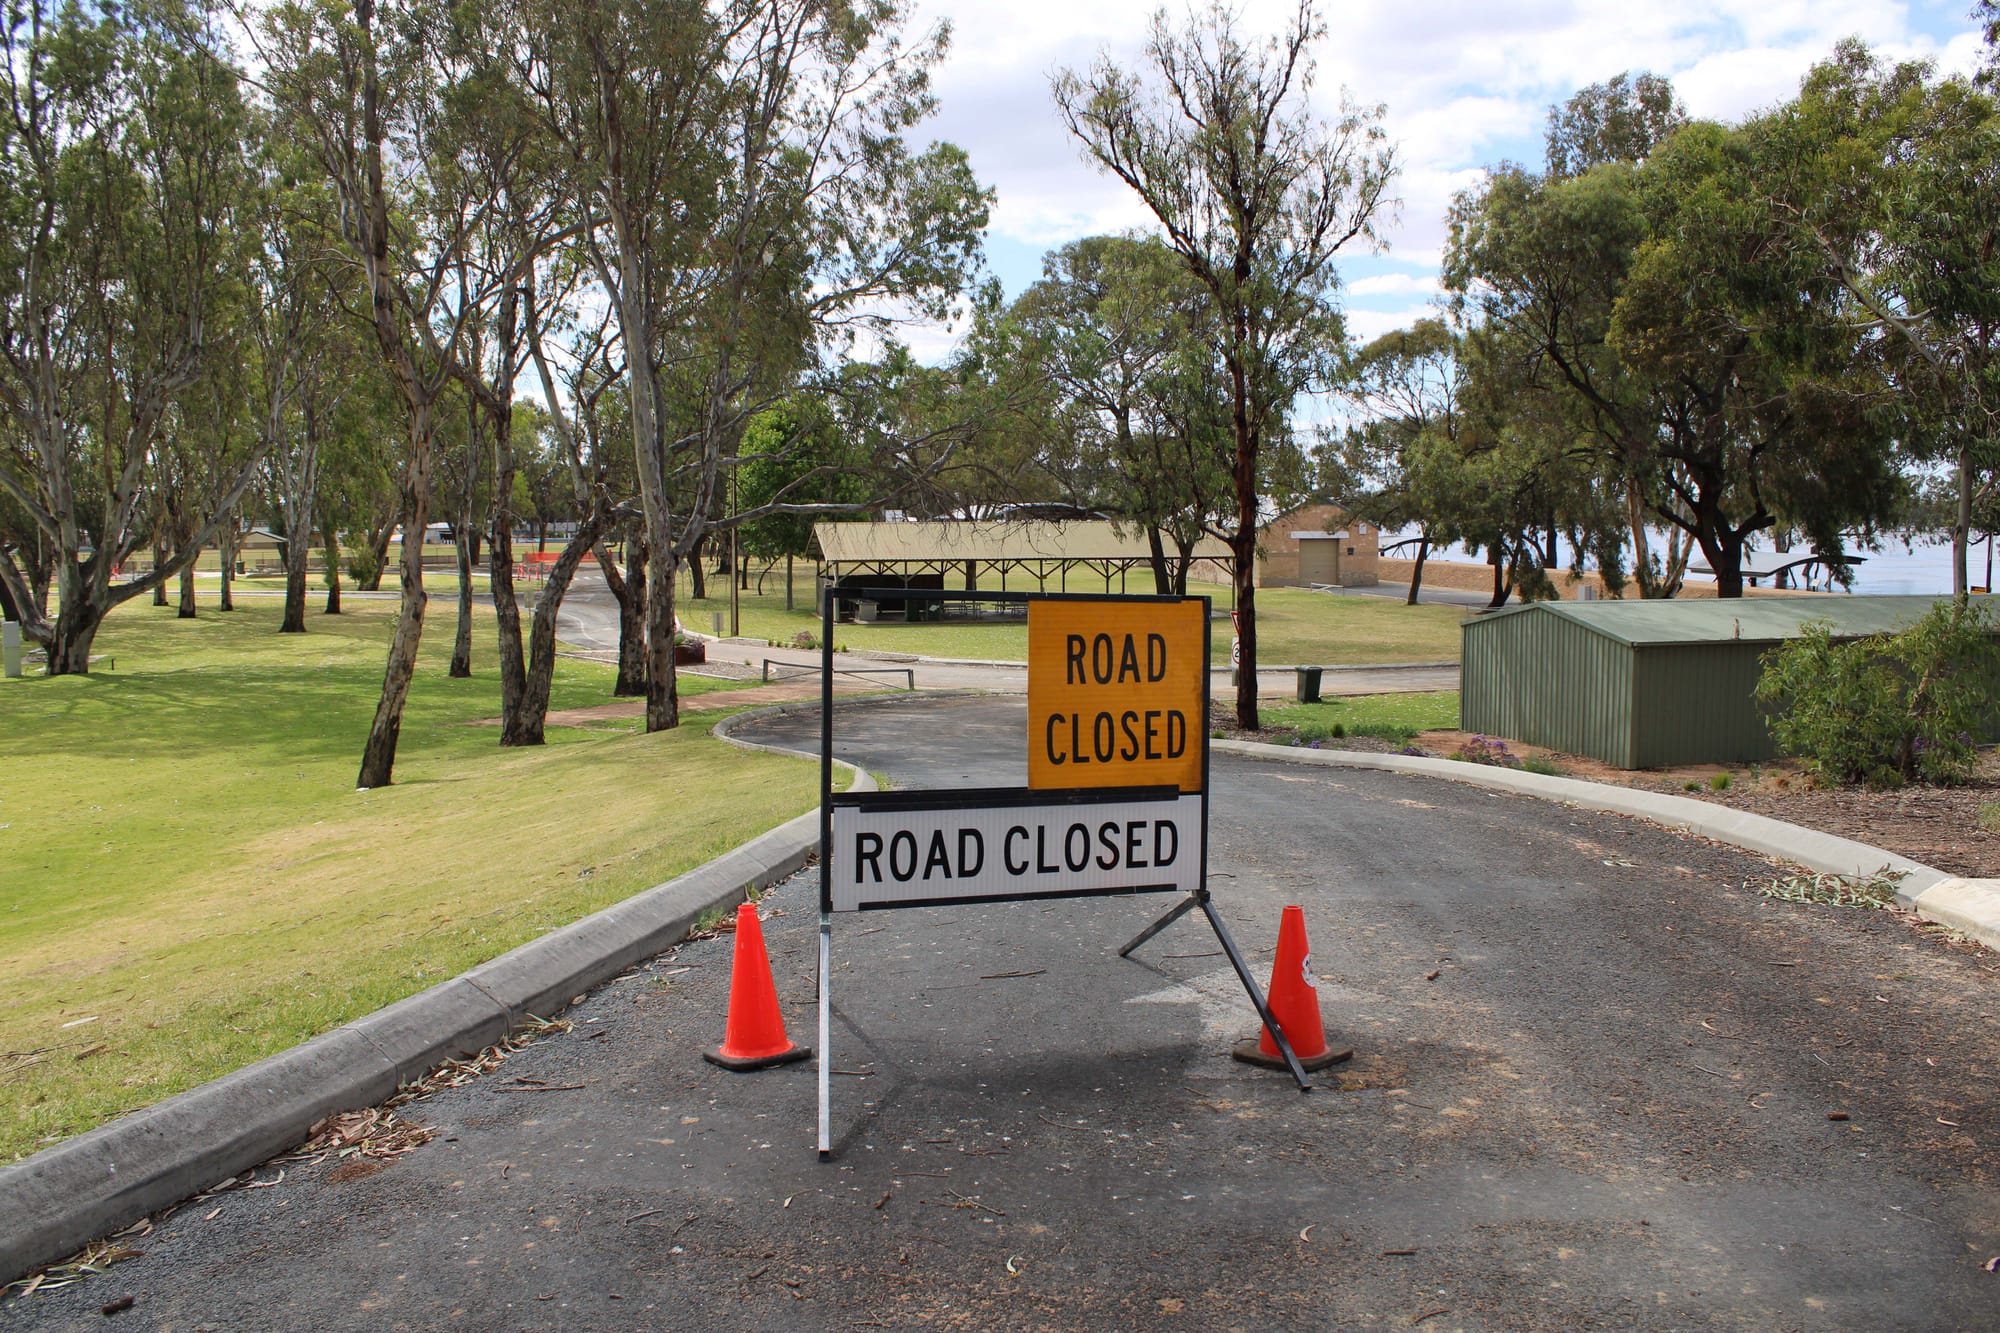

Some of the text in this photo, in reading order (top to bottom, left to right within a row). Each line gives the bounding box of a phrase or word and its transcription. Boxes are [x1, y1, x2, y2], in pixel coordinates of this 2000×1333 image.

[1066, 633, 1167, 685] ROAD
[1046, 709, 1187, 766] CLOSED
[855, 819, 1179, 884] ROAD CLOSED
